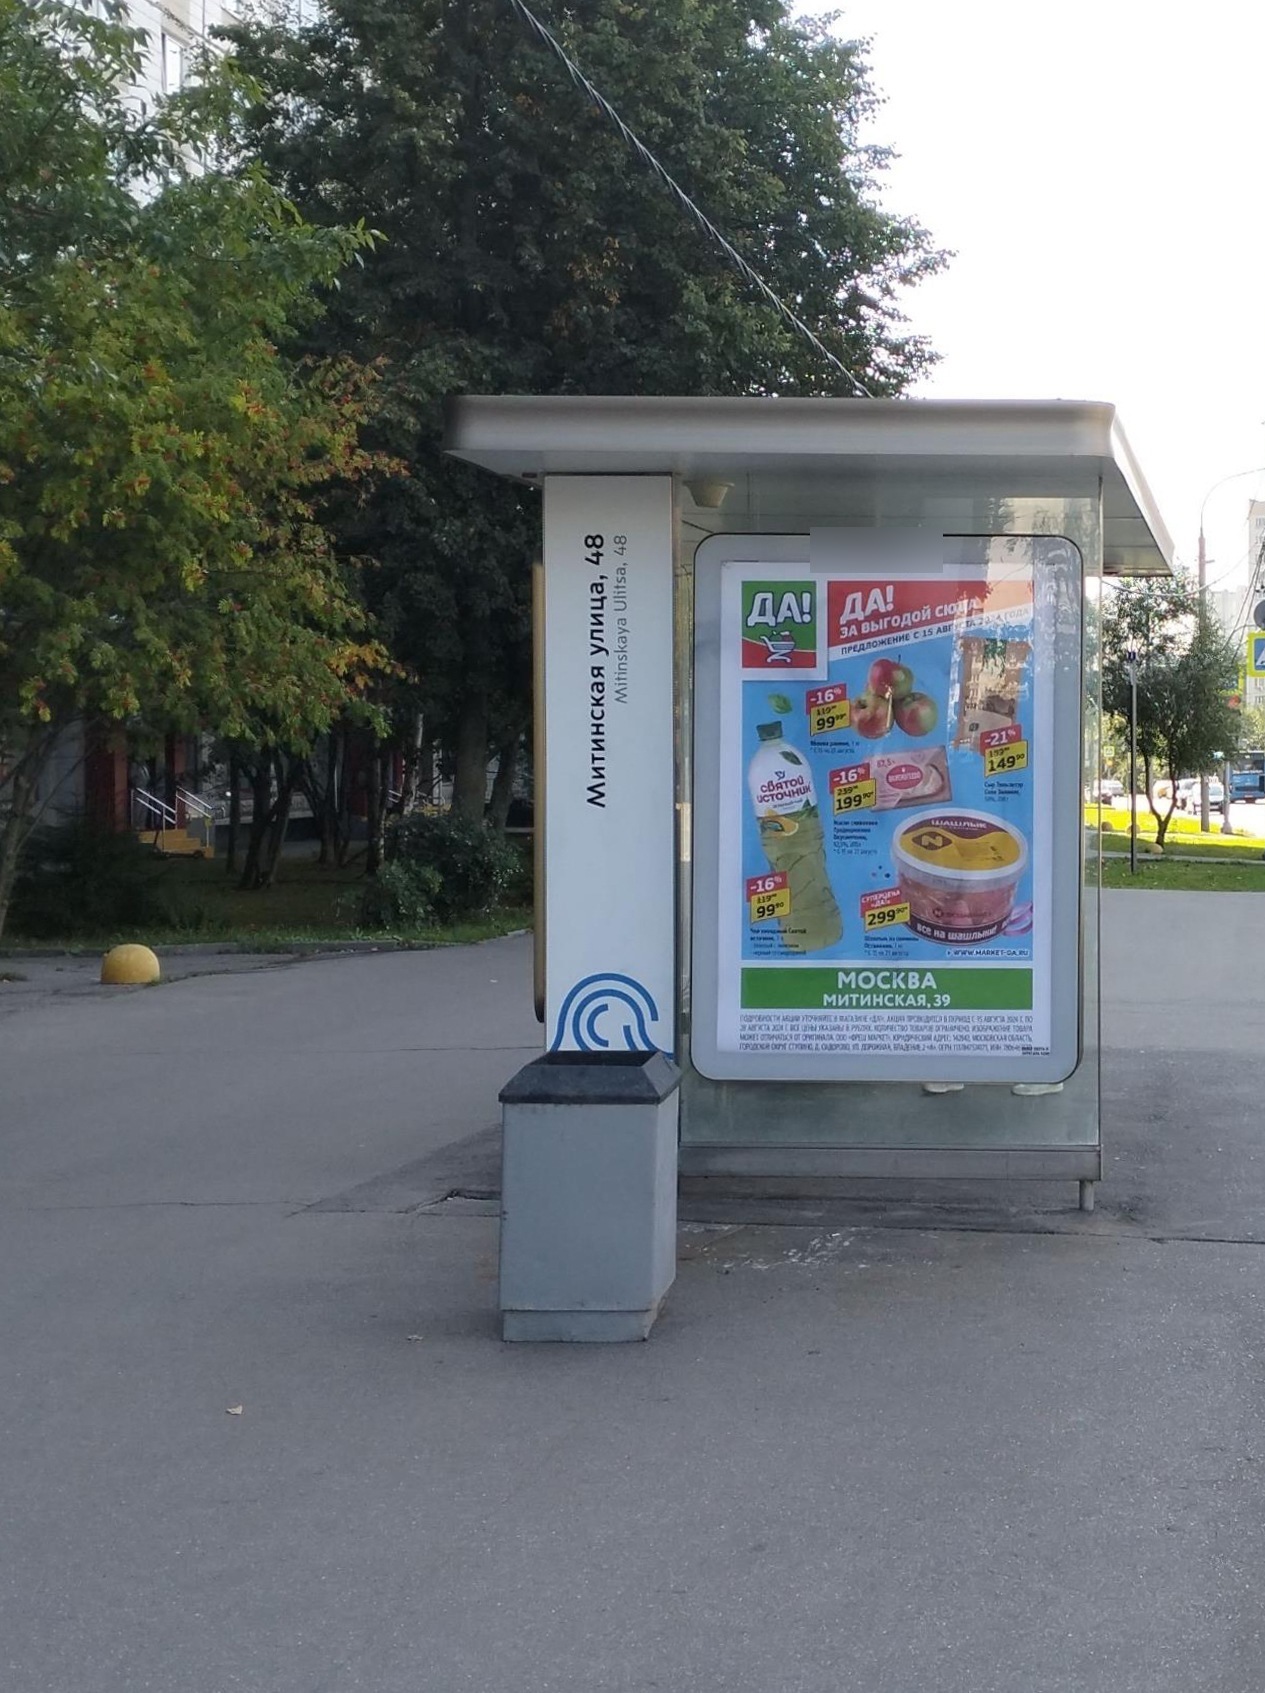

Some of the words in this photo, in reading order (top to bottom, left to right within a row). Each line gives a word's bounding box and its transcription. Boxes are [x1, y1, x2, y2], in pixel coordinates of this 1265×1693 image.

[584, 533, 605, 566] 48
[614, 534, 627, 556] 48
[613, 562, 628, 612] Ulitsa,
[589, 574, 609, 656] улица,
[747, 592, 811, 626] ДА!
[840, 585, 894, 624] ДА!
[840, 625, 857, 639] ЗА
[861, 606, 931, 634] ВЫГОДОЙ
[841, 634, 910, 655] ПРЕДЛОЖЕНИЕ
[922, 628, 933, 638] 15
[614, 617, 631, 704] Mitinskaya
[586, 666, 606, 808] Митинская
[838, 972, 937, 989] МОСКВА
